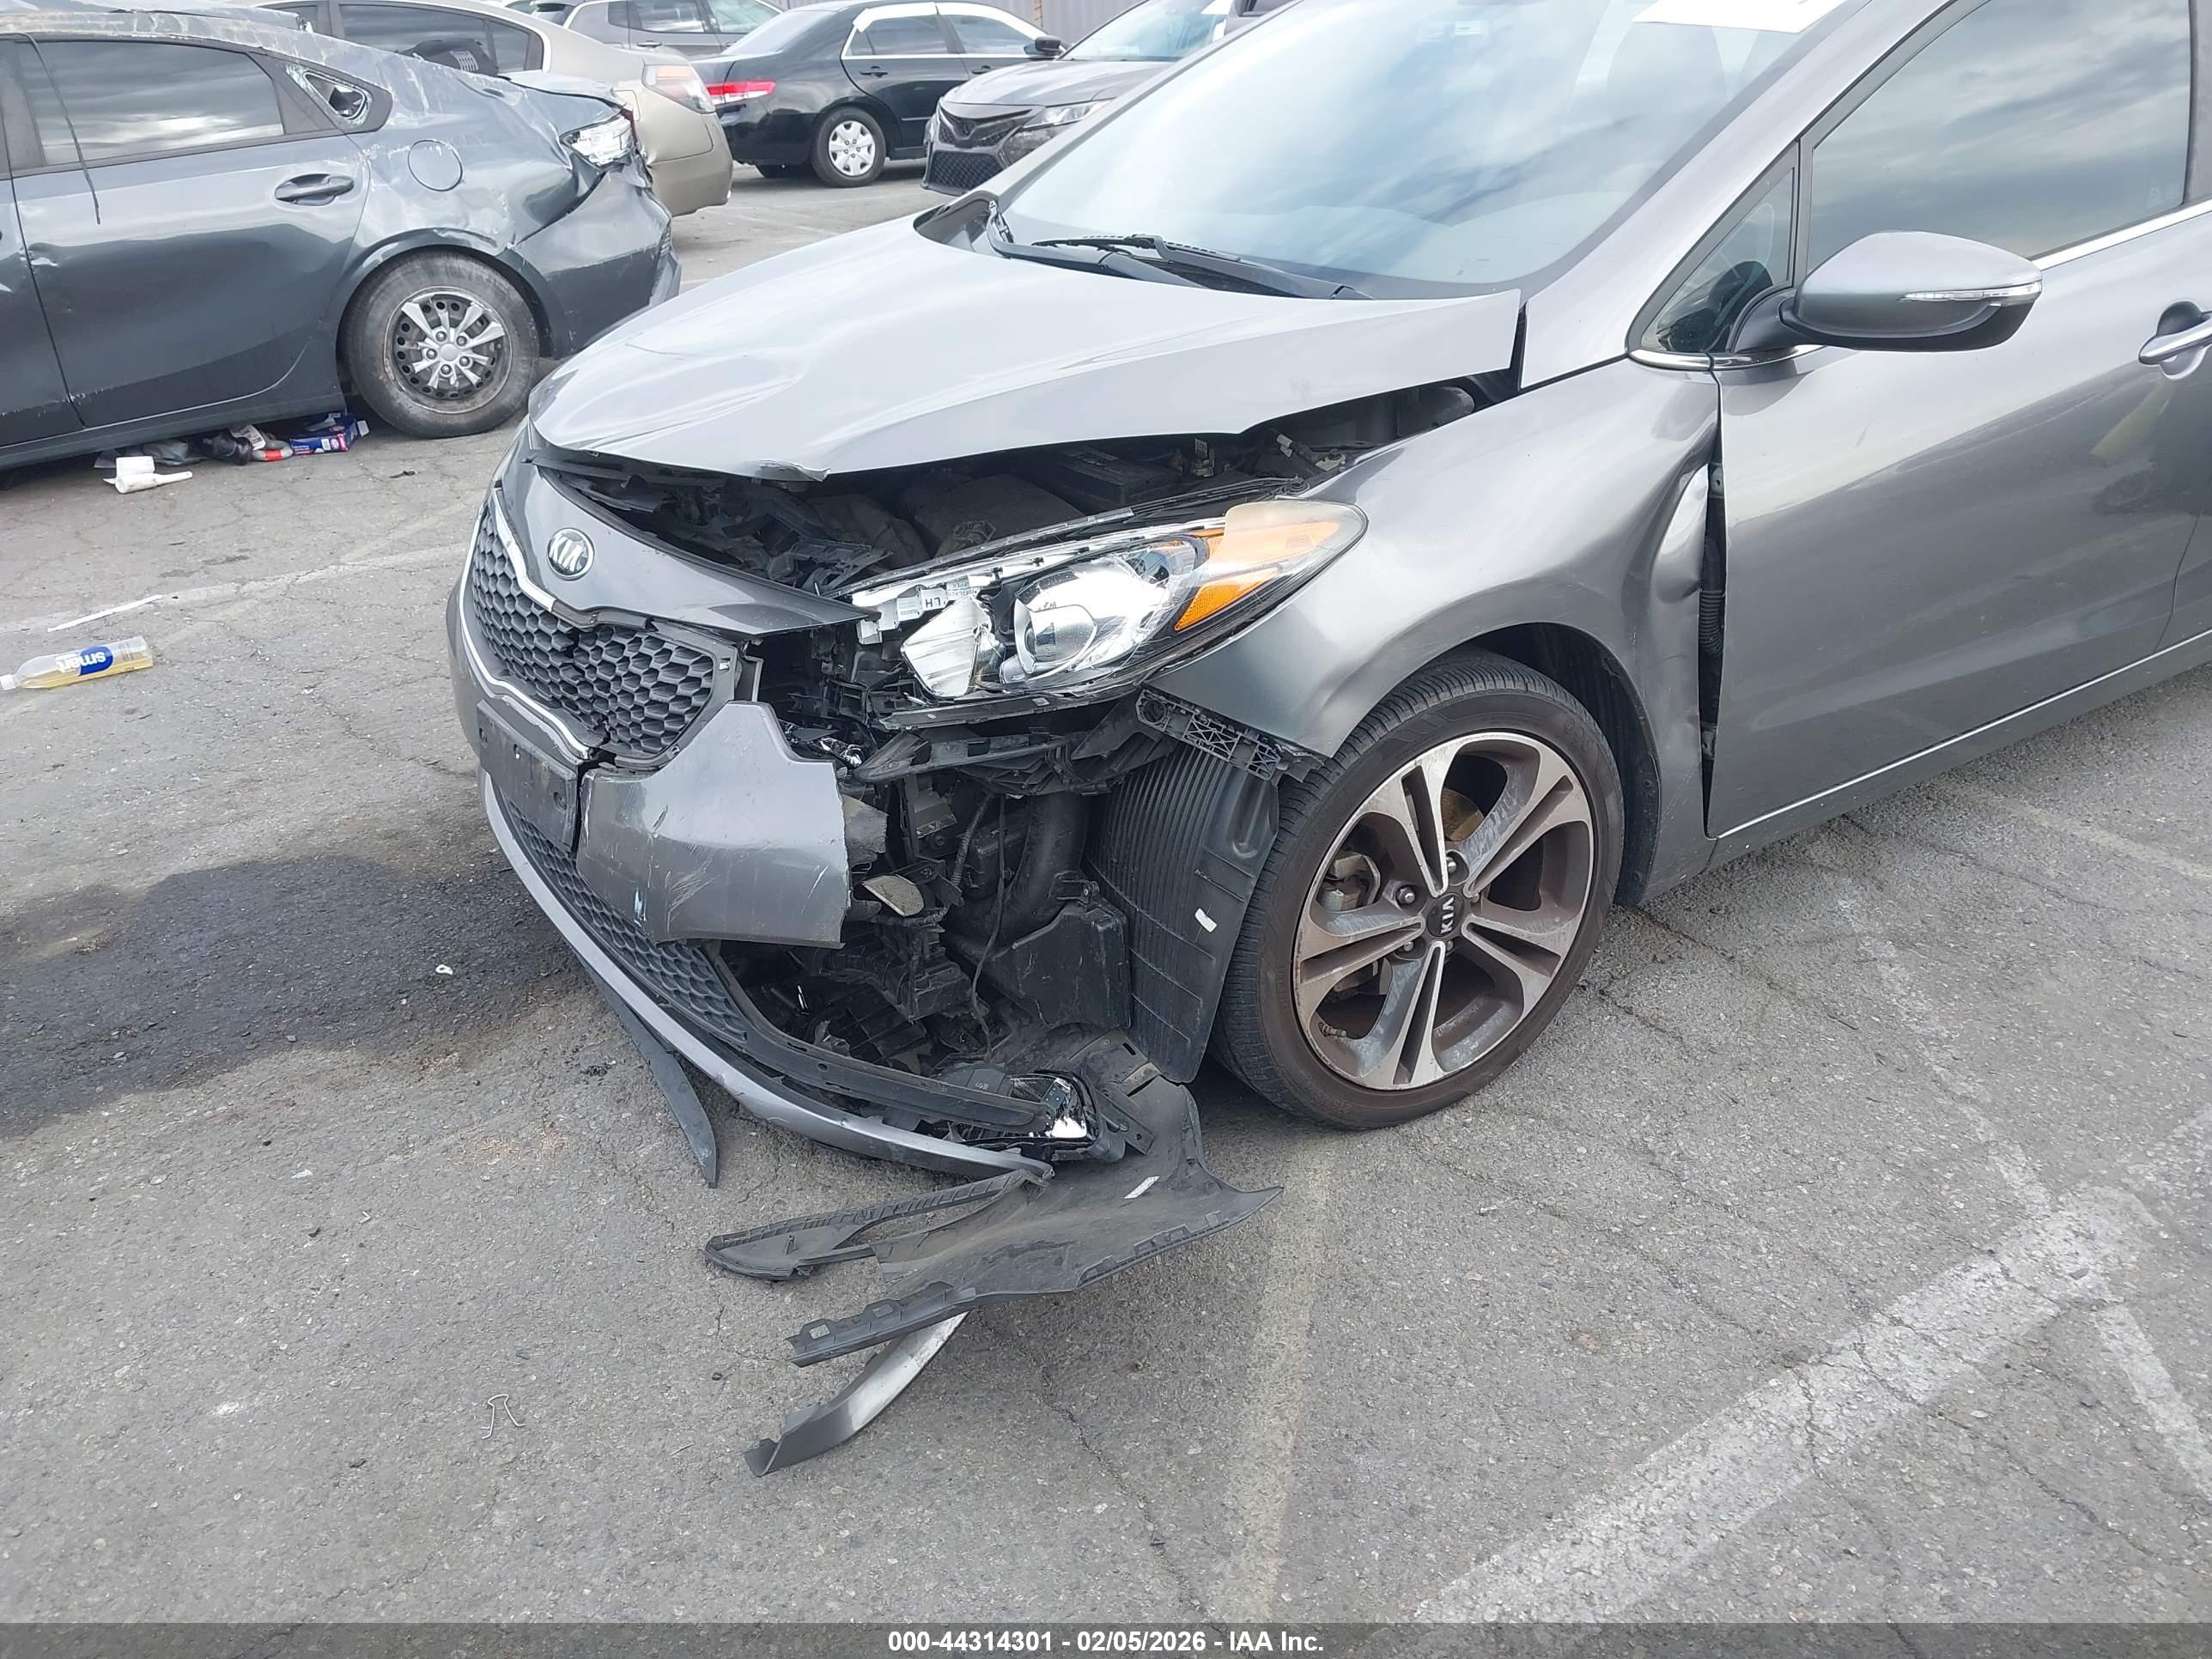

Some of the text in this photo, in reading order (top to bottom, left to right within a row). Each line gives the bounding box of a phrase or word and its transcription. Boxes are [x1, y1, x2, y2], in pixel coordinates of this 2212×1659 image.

[549, 534, 583, 573] KIA
[925, 597, 941, 609] LH
[56, 651, 106, 673] smart
[1440, 896, 1454, 934] KIA
